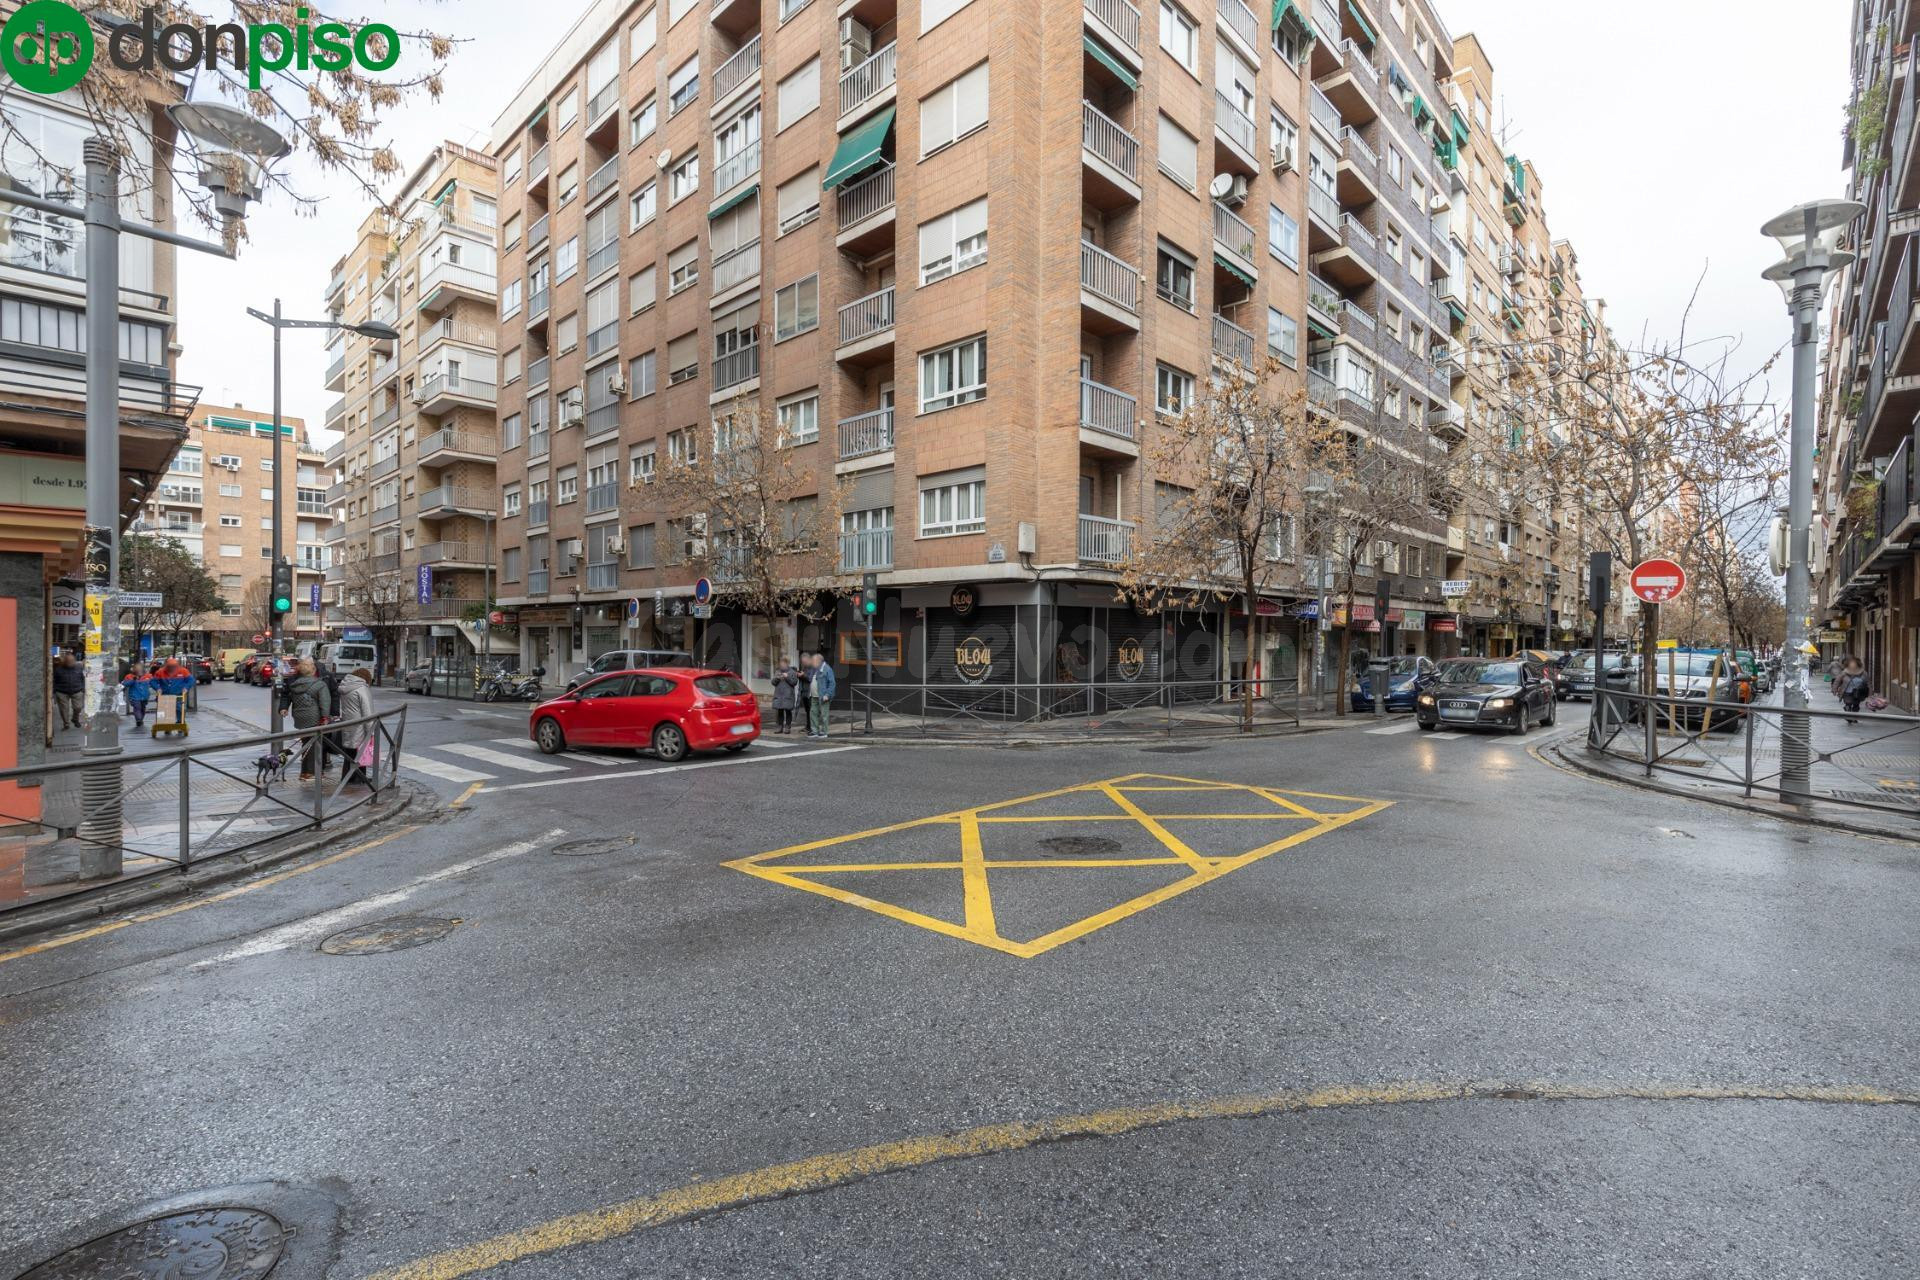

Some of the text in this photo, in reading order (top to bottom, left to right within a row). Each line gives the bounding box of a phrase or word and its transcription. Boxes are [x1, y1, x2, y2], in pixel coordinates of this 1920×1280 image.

[32, 475, 65, 487] desde
[420, 566, 429, 604] HOSTAL
[955, 647, 991, 665] BLOW
[1119, 647, 1144, 664] BLOW
